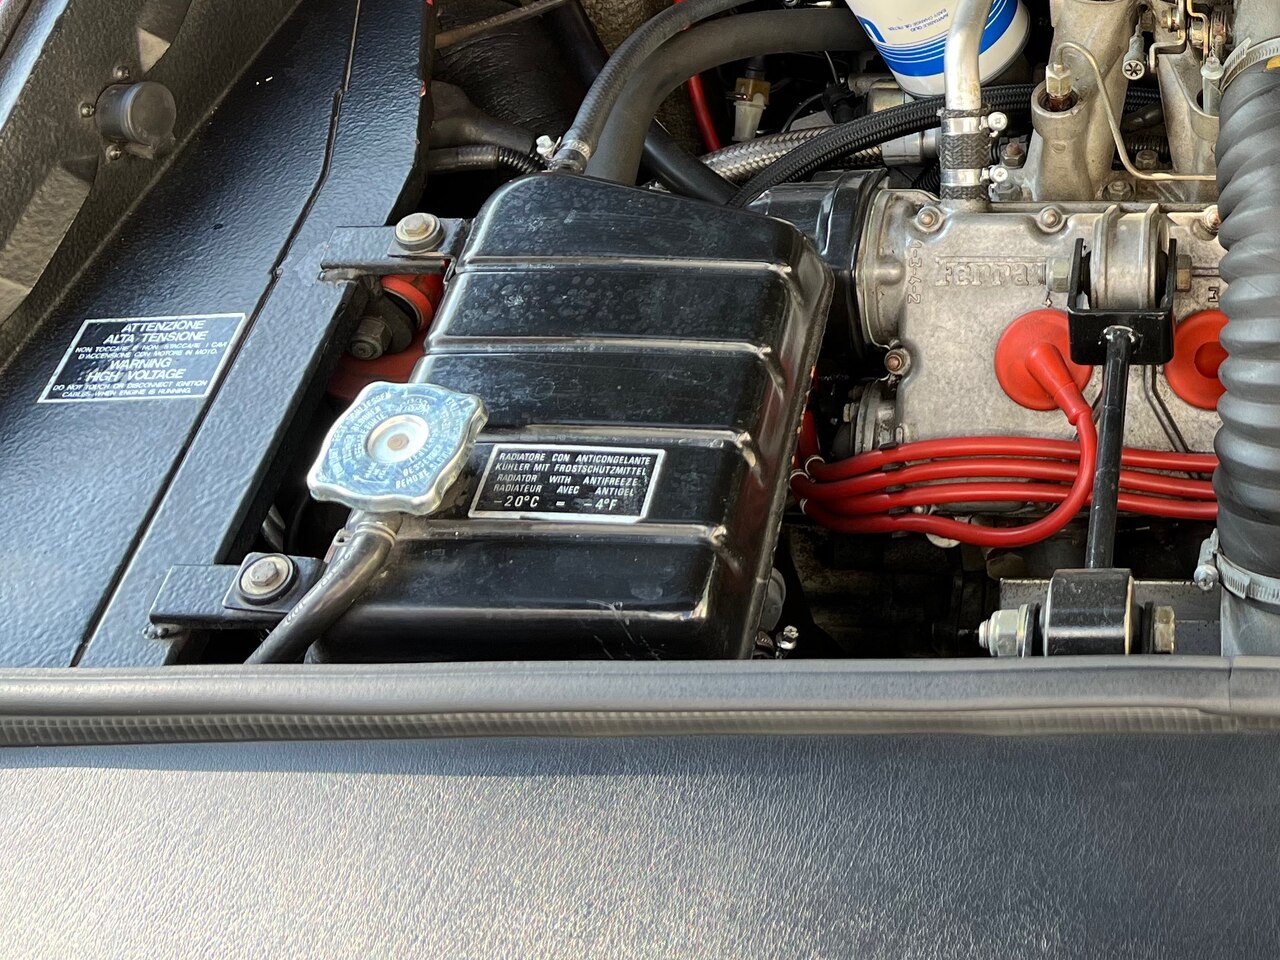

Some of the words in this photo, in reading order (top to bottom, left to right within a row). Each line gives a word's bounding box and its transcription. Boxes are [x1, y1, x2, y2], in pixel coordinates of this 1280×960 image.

[121, 320, 206, 333] ATTENZIONE
[103, 334, 136, 345] ALTA
[142, 331, 208, 343] TENSIONE
[110, 358, 172, 369] WARNING
[86, 371, 120, 382] HIGH
[127, 369, 186, 380] VOLTAGE
[127, 381, 173, 389] DISCONNECT
[499, 452, 548, 462] RADIATORE
[552, 453, 573, 462] CON
[576, 454, 651, 465] ANTICONGELANTE
[532, 463, 552, 472] MIT
[553, 464, 647, 476] FROSTSCHUTZMITTEL
[497, 473, 538, 483] RADIATOR
[548, 475, 572, 484] WITH
[583, 475, 639, 486] ANTIFREEZE
[494, 484, 542, 493] RADIATEUR
[556, 485, 580, 494] AVEC
[595, 486, 635, 496] ANTIGEL
